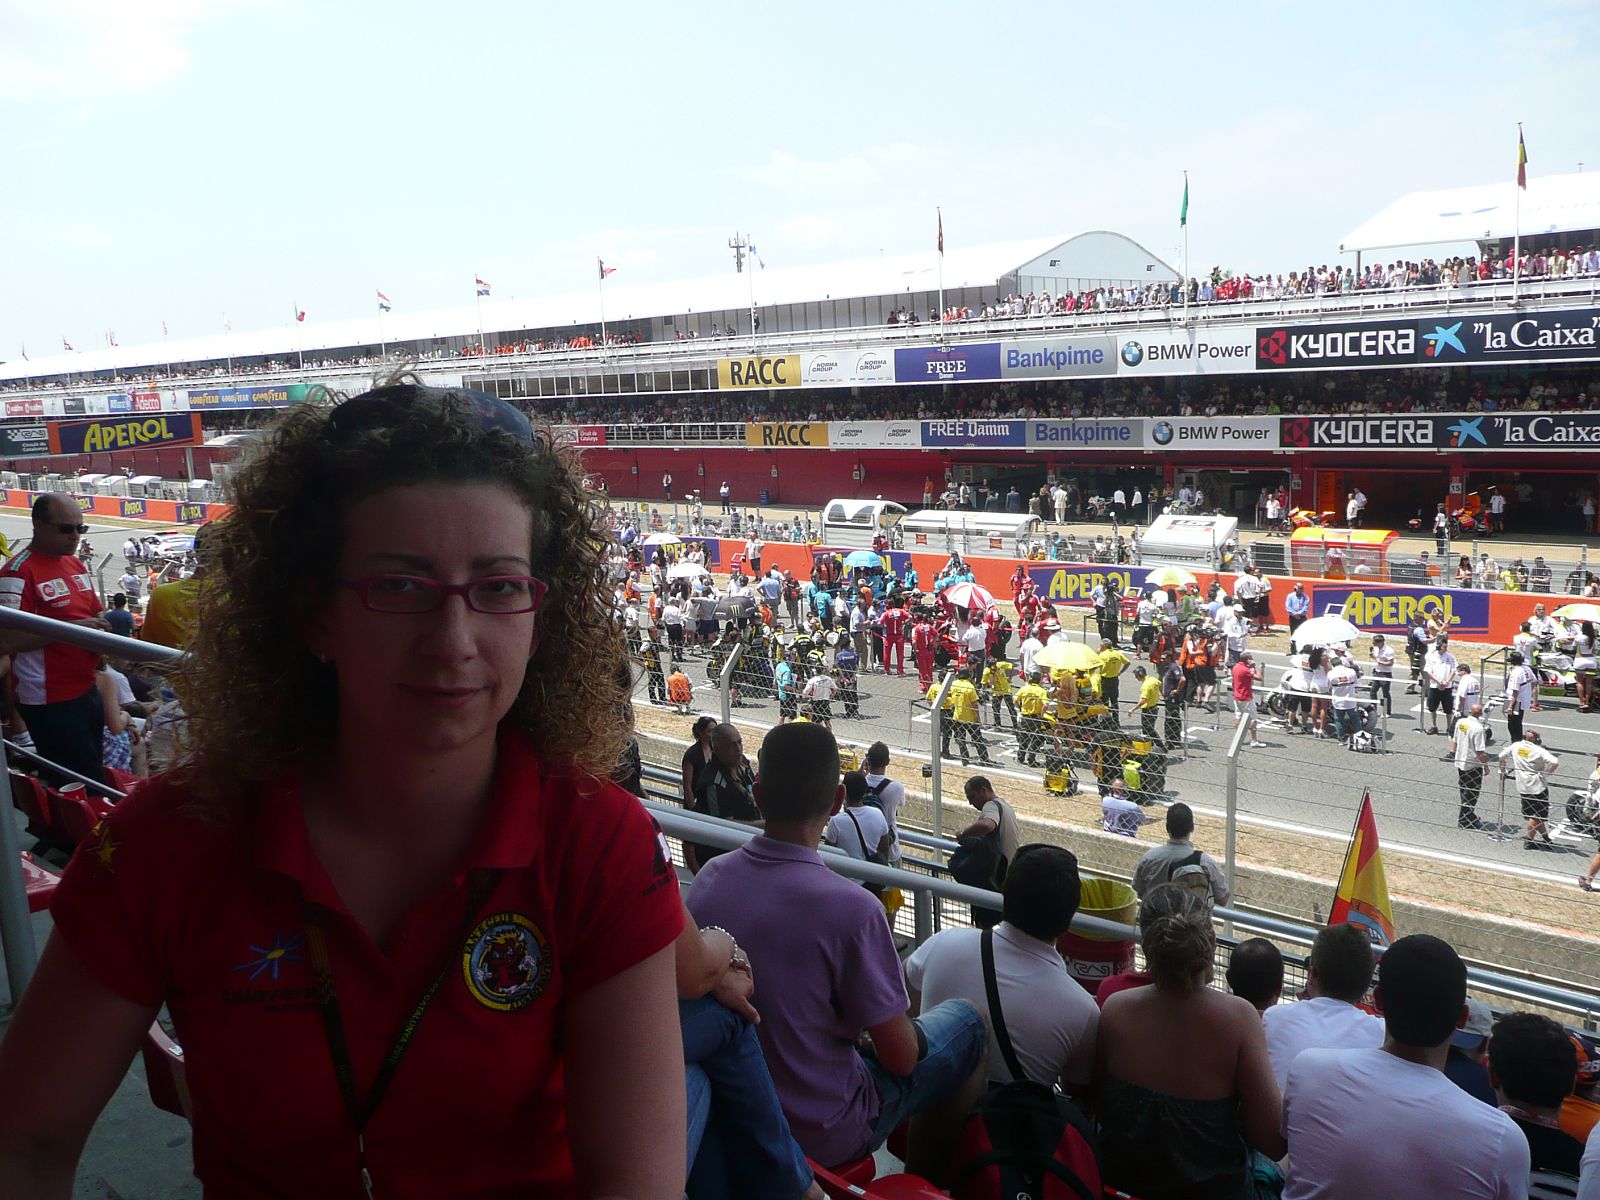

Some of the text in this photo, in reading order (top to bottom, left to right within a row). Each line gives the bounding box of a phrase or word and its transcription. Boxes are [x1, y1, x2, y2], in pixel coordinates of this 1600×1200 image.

[1148, 343, 1193, 361] BMW
[1197, 343, 1252, 359] Power
[1290, 328, 1417, 359] KYOCERA
[864, 359, 887, 367] NORMA
[926, 360, 966, 374] FREE
[1006, 346, 1104, 371] Bankpime
[730, 358, 787, 386] RACC
[84, 418, 174, 453] APEROL
[762, 424, 812, 447] RACC
[929, 421, 1010, 438] FREE Damm
[1035, 422, 1131, 445] Bankpime
[1180, 427, 1270, 440] BMW Power
[1313, 420, 1434, 444] KYOCERA
[1342, 591, 1461, 626] APEROL
